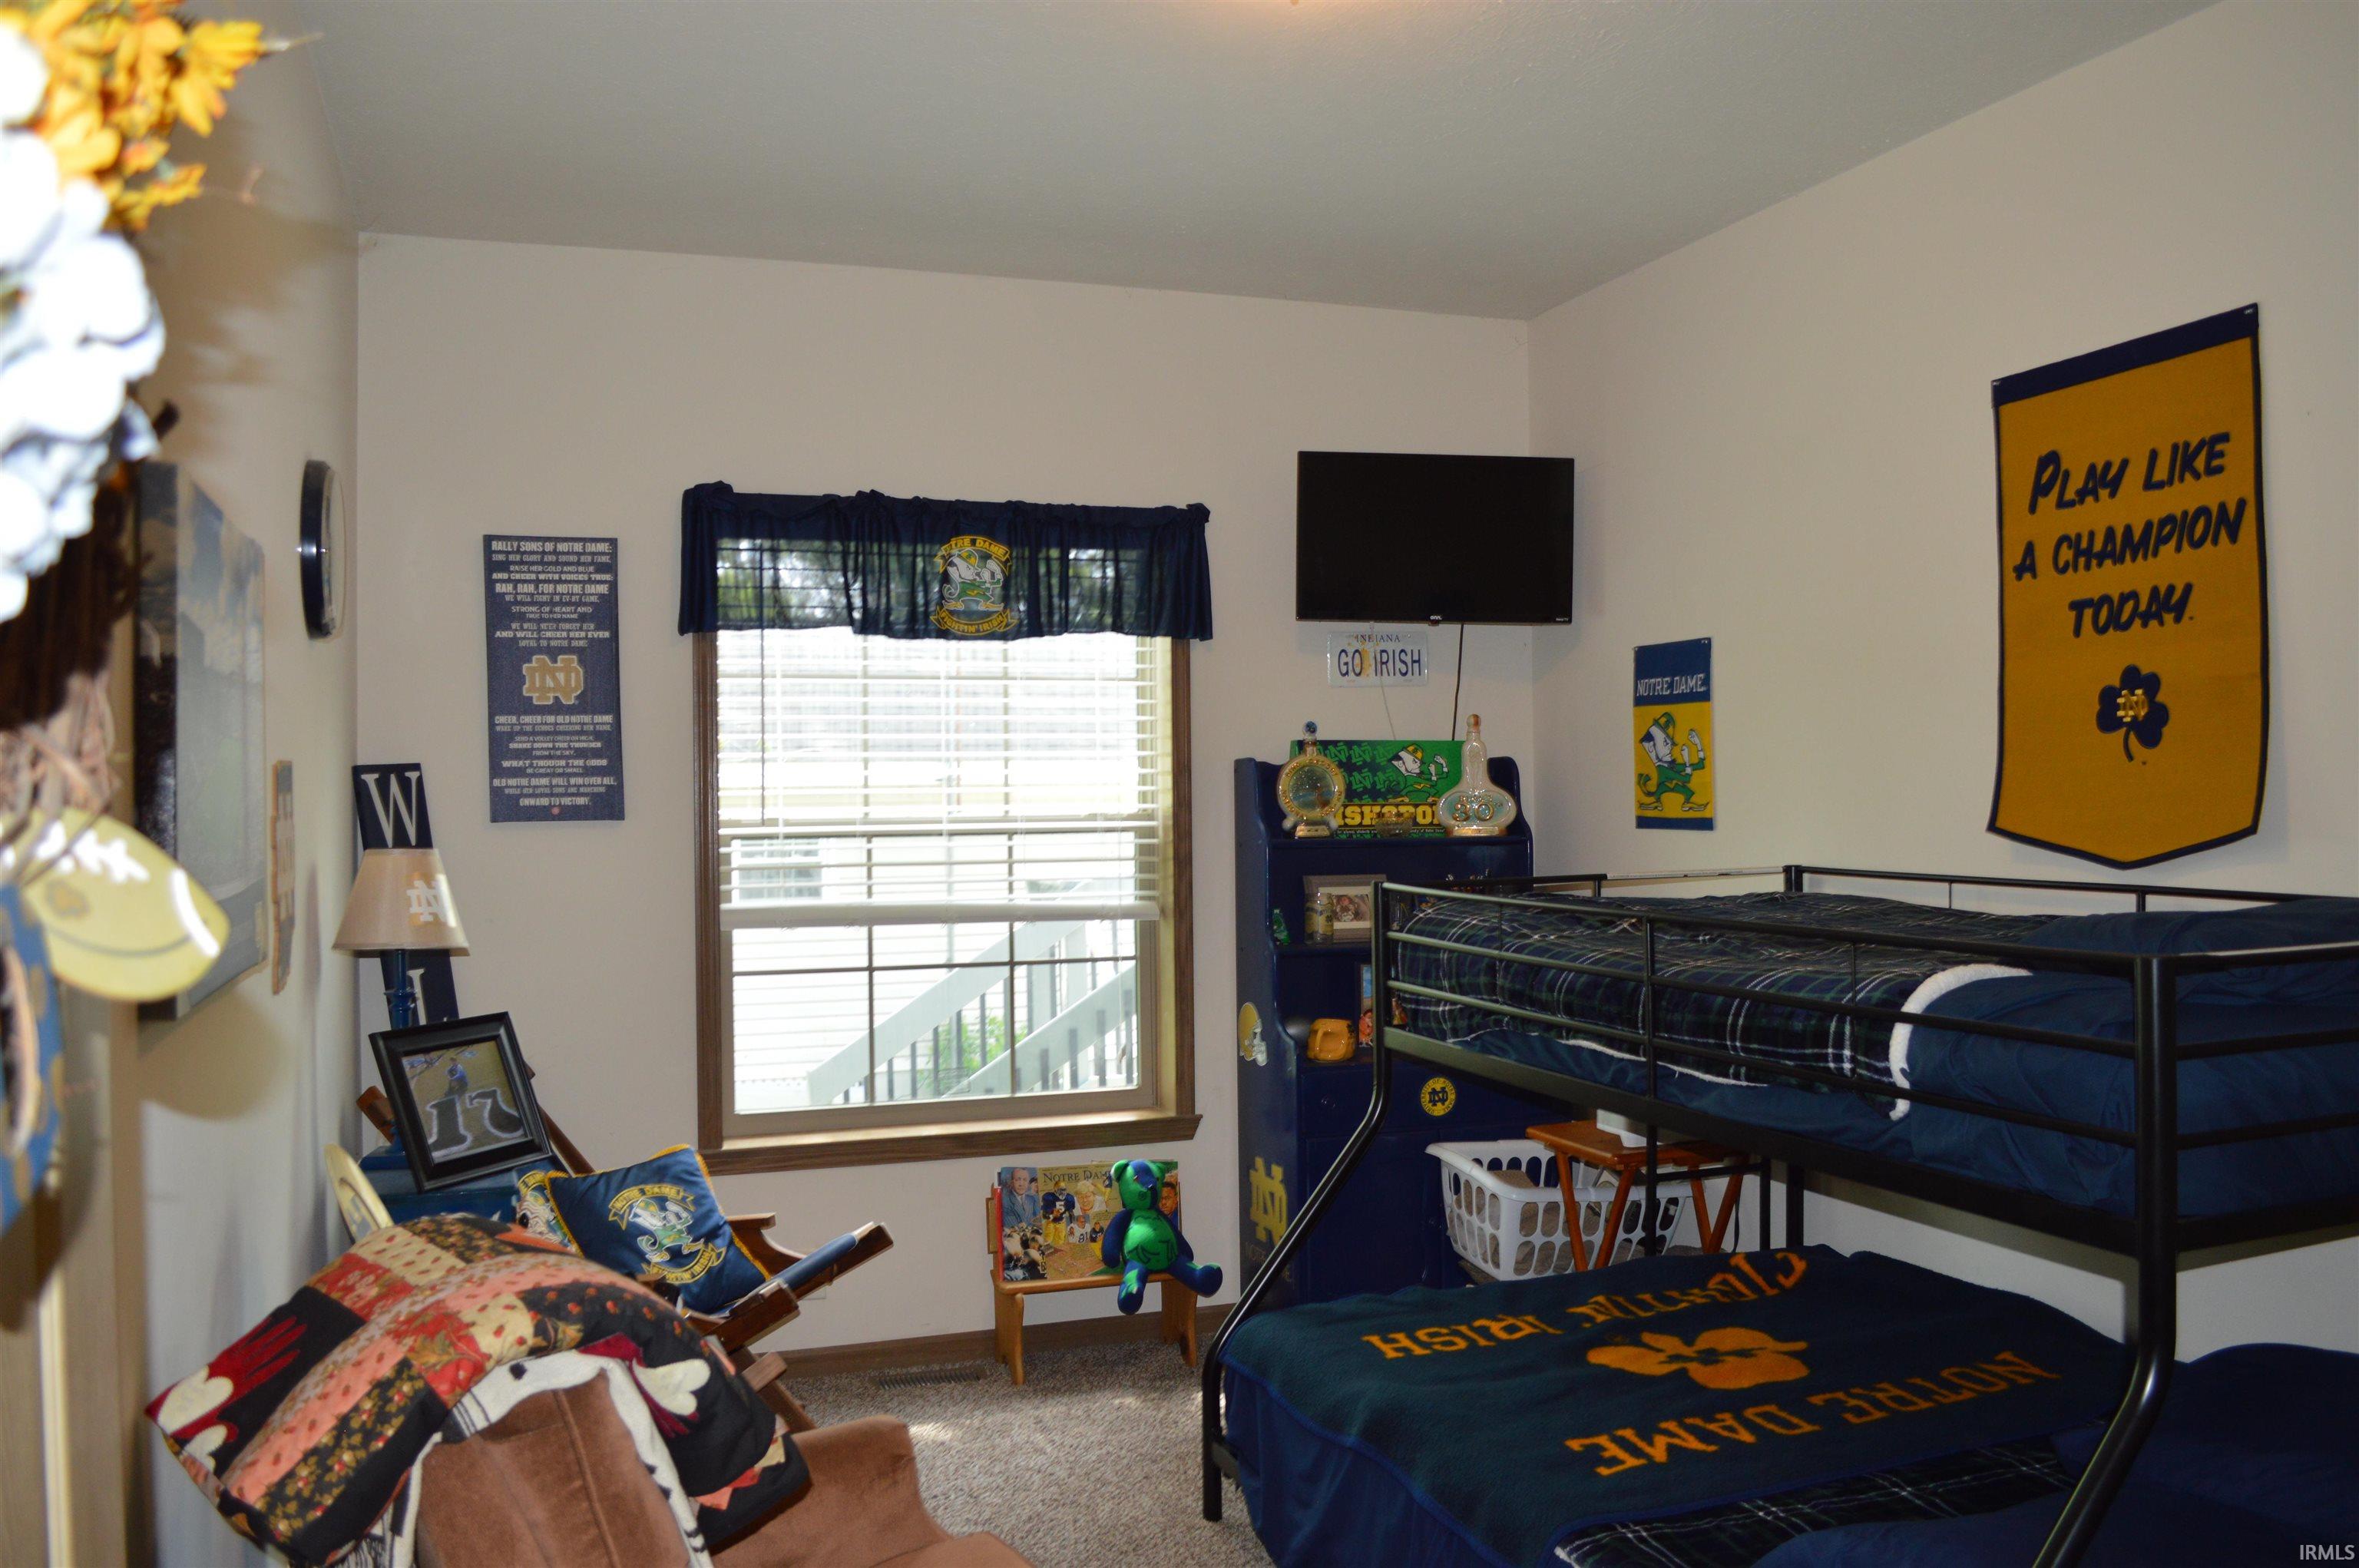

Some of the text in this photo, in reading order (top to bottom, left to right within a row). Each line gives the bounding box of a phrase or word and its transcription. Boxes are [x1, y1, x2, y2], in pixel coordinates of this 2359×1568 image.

[2028, 432, 2230, 514] PLAY LIKE
[491, 541, 518, 551] RALLY
[520, 541, 543, 551] SONS
[544, 542, 554, 552] OF
[557, 542, 583, 552] NOTRE
[975, 538, 1007, 557] DAME
[2013, 497, 2247, 582] A CHAMPION
[539, 584, 554, 594] FOR
[557, 584, 583, 594] NOTRE
[585, 584, 609, 594] DAME
[1338, 648, 1421, 676] GO IRISH
[1636, 676, 1671, 696] NOTRE
[594, 715, 613, 723] DAME
[493, 778, 505, 786] OLD
[508, 777, 528, 786] NOTRE
[531, 777, 550, 786] DAME
[552, 777, 567, 786] WILL
[570, 777, 584, 786] WIN
[585, 777, 602, 786] OVER
[520, 797, 549, 806] ONWARD
[551, 797, 559, 806] TO
[1043, 1171, 1081, 1184] NOTRE
[1361, 1314, 1563, 1359] IRISH
[1563, 1350, 2063, 1477] NOTRE DAME
